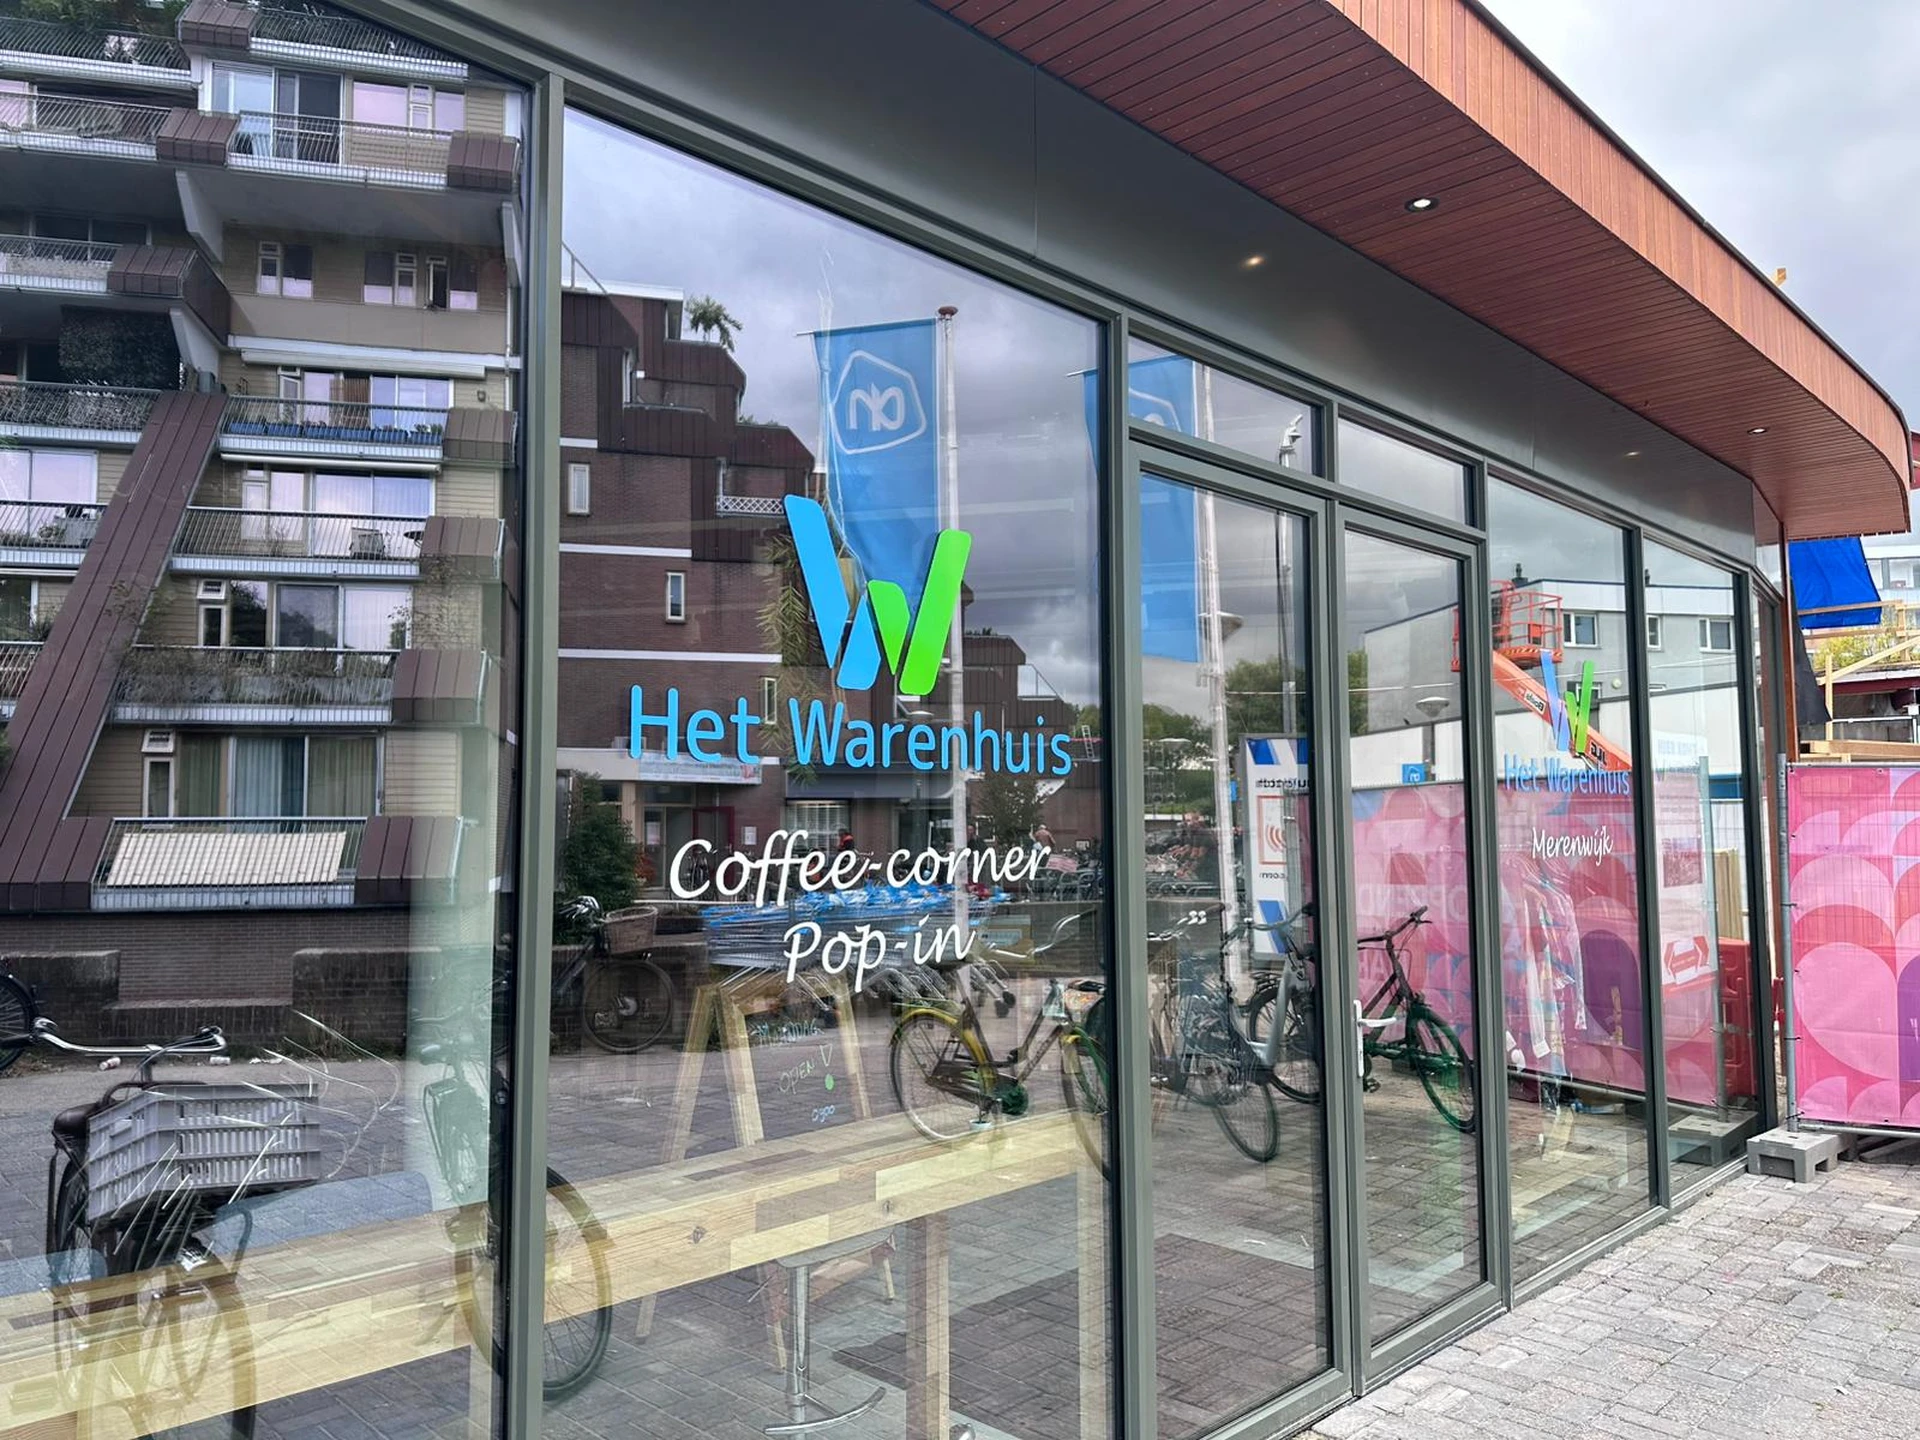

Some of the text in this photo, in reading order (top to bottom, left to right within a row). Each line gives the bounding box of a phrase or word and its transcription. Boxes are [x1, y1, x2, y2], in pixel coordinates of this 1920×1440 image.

[630, 684, 1072, 776] Het Warenhuis
[1504, 753, 1630, 796] Het Warenhuis
[669, 829, 1052, 908] Coffee-corner
[1532, 826, 1614, 866] Merenwijk
[782, 914, 977, 993] Pop-in
